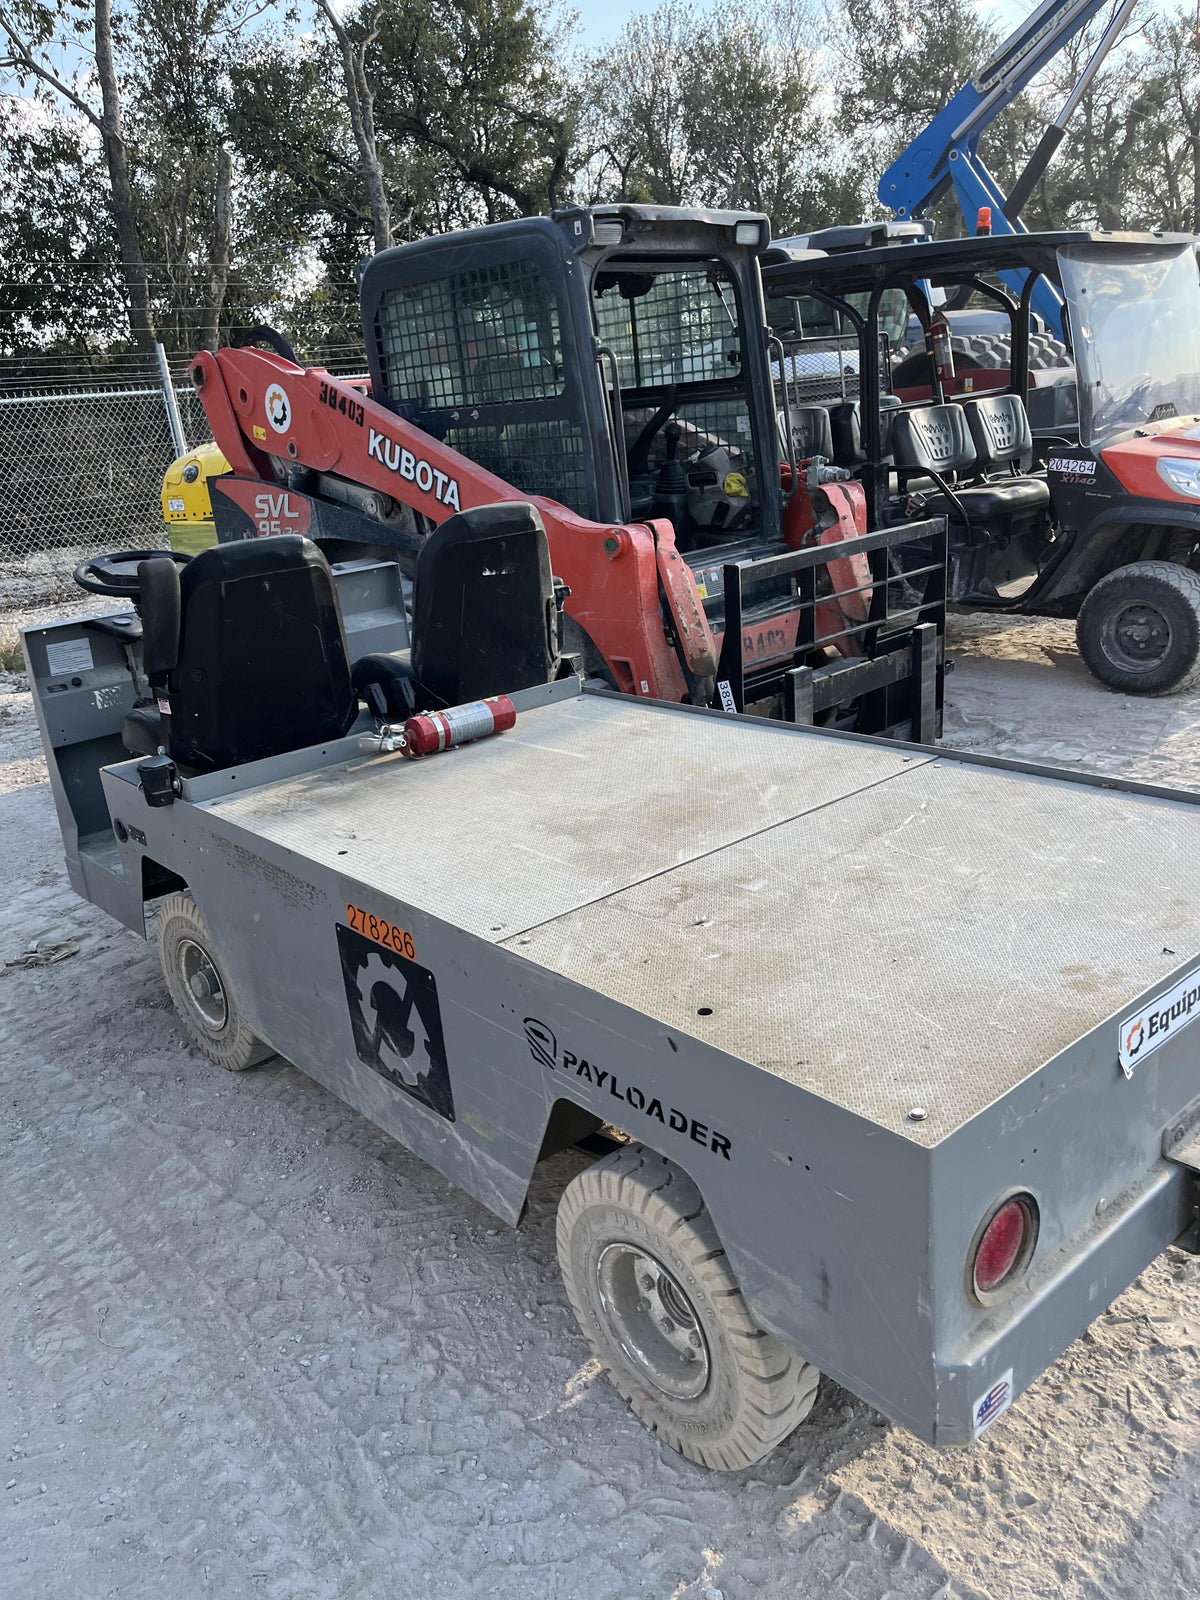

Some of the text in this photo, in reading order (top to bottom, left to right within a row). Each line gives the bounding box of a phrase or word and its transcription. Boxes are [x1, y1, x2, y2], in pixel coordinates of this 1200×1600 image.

[319, 381, 365, 427] 38403
[368, 427, 461, 512] KUBOTA
[1049, 458, 1095, 474] 204264
[254, 494, 300, 519] SVL
[347, 904, 415, 959] 278266
[1148, 985, 1200, 1040] Equip
[563, 1050, 732, 1161] PAYLOADER
